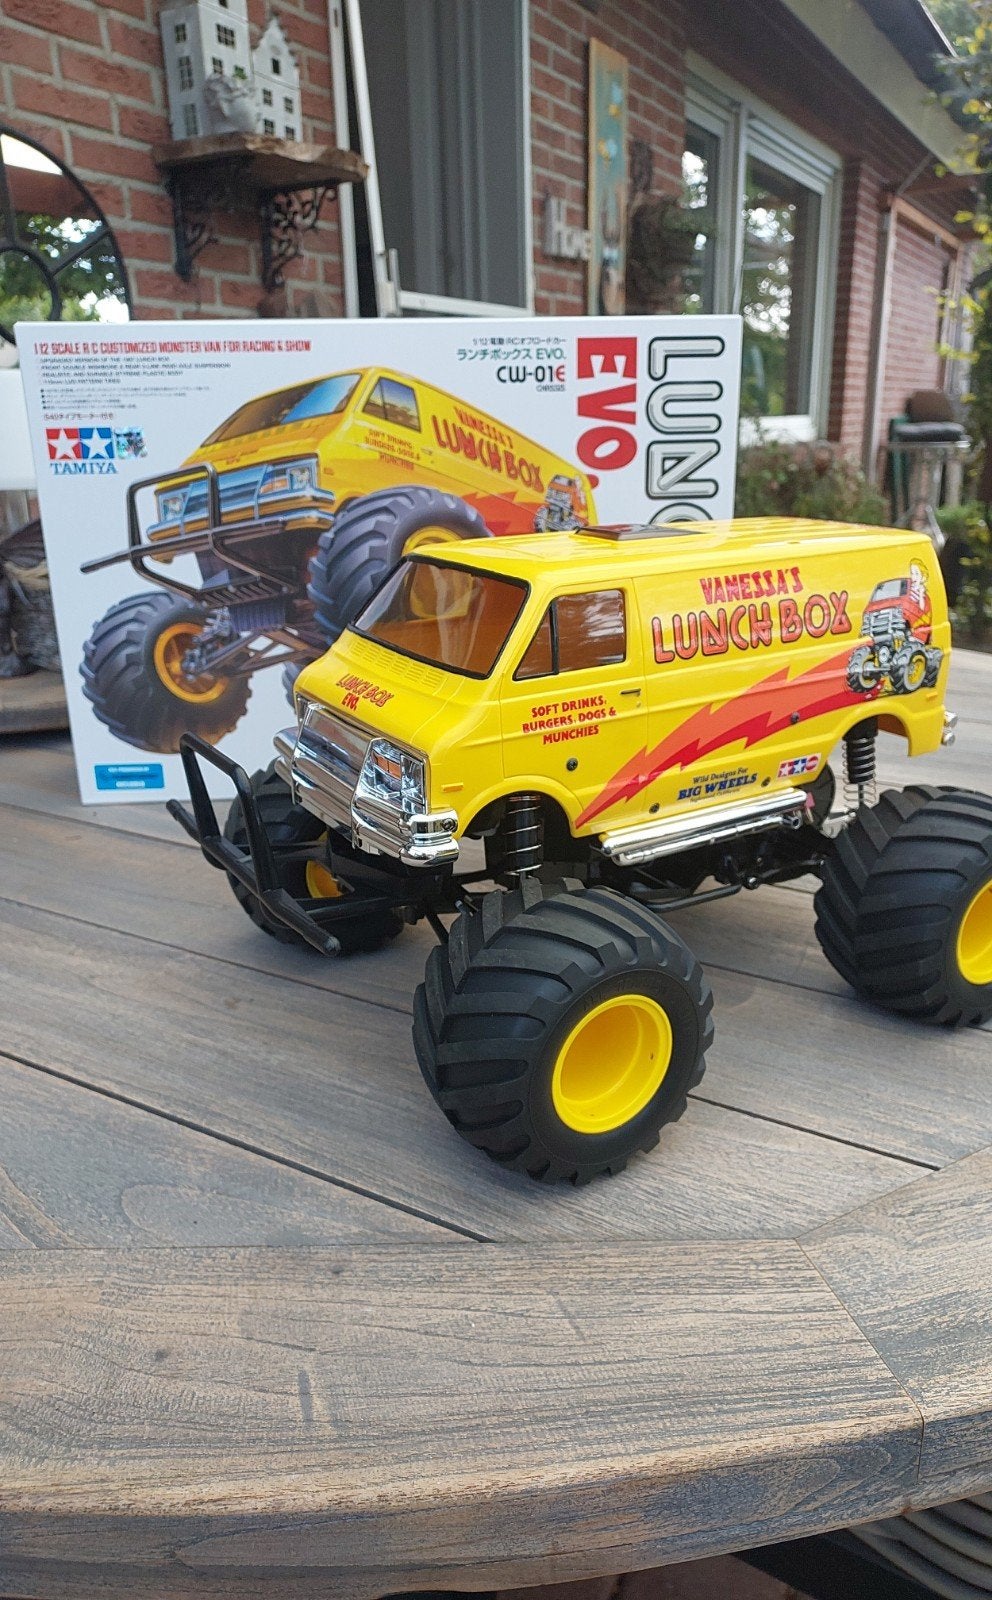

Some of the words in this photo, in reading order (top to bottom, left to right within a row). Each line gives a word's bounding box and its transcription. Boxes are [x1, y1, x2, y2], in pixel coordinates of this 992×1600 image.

[457, 348, 532, 360] ランチボックス
[431, 414, 502, 473] LUNCH
[505, 450, 545, 493] BOX
[50, 462, 118, 475] TAMIYA
[700, 566, 804, 605] VANESSA'S
[652, 602, 772, 664] LUNCH
[778, 590, 852, 644] BOX
[362, 686, 394, 707] BOX
[531, 703, 559, 718] SOFT
[561, 695, 607, 712] DRINKS,
[522, 714, 576, 733] BURGERS,
[578, 708, 606, 722] DOGS
[608, 706, 616, 716] &
[542, 724, 599, 745] MUNCHIES
[677, 785, 702, 800] BIG
[704, 773, 758, 796] WHEELS
[693, 774, 709, 784] Wild
[710, 769, 736, 781] Designs
[737, 767, 748, 775] For
